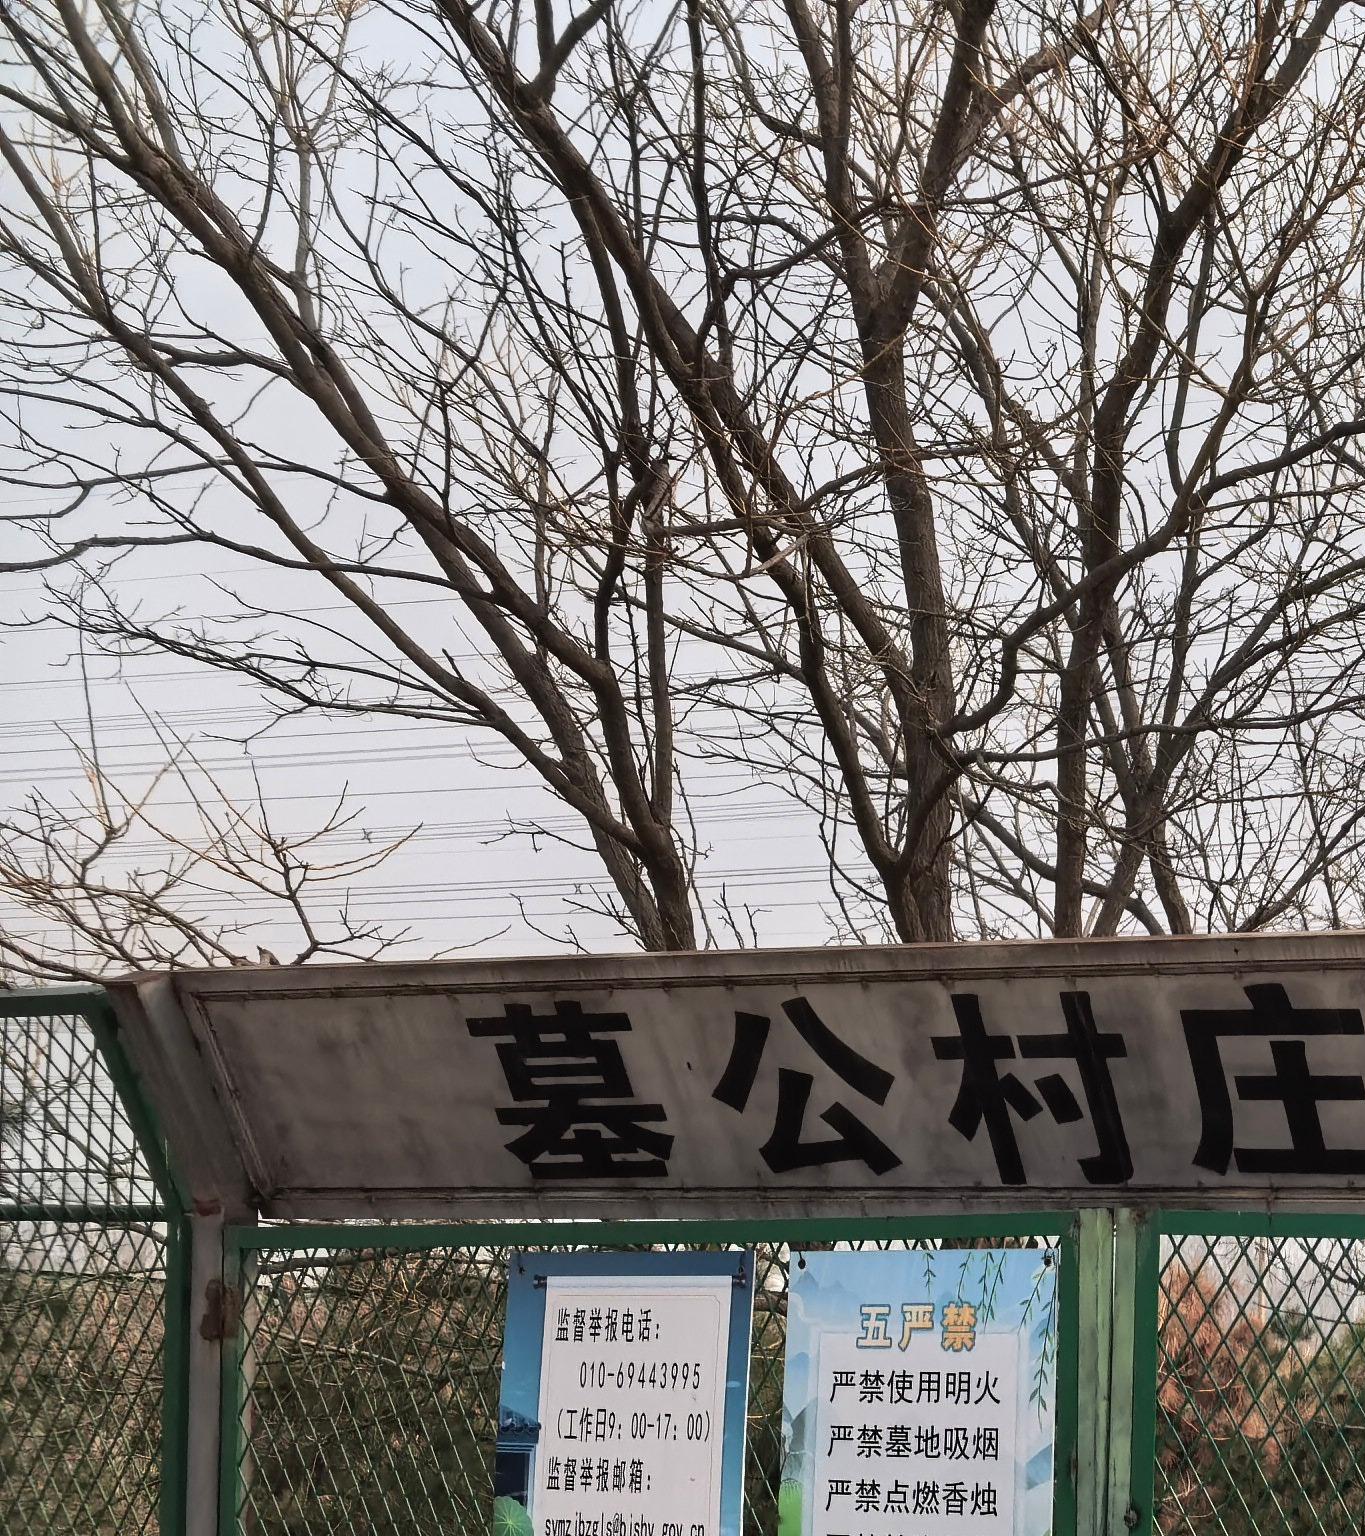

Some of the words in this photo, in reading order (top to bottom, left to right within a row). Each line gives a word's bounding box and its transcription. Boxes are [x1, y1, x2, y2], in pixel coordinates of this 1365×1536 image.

[554, 1307, 661, 1344] 监督举报电话：
[856, 1302, 978, 1352] 五严禁
[579, 1360, 701, 1391] 010-69443995
[829, 1369, 1001, 1406] 严禁使用明火
[827, 1424, 1000, 1461] 严禁墓地吸烟
[546, 1456, 653, 1494] 监督举报邮箱：
[825, 1478, 998, 1518] 严禁点燃香烛
